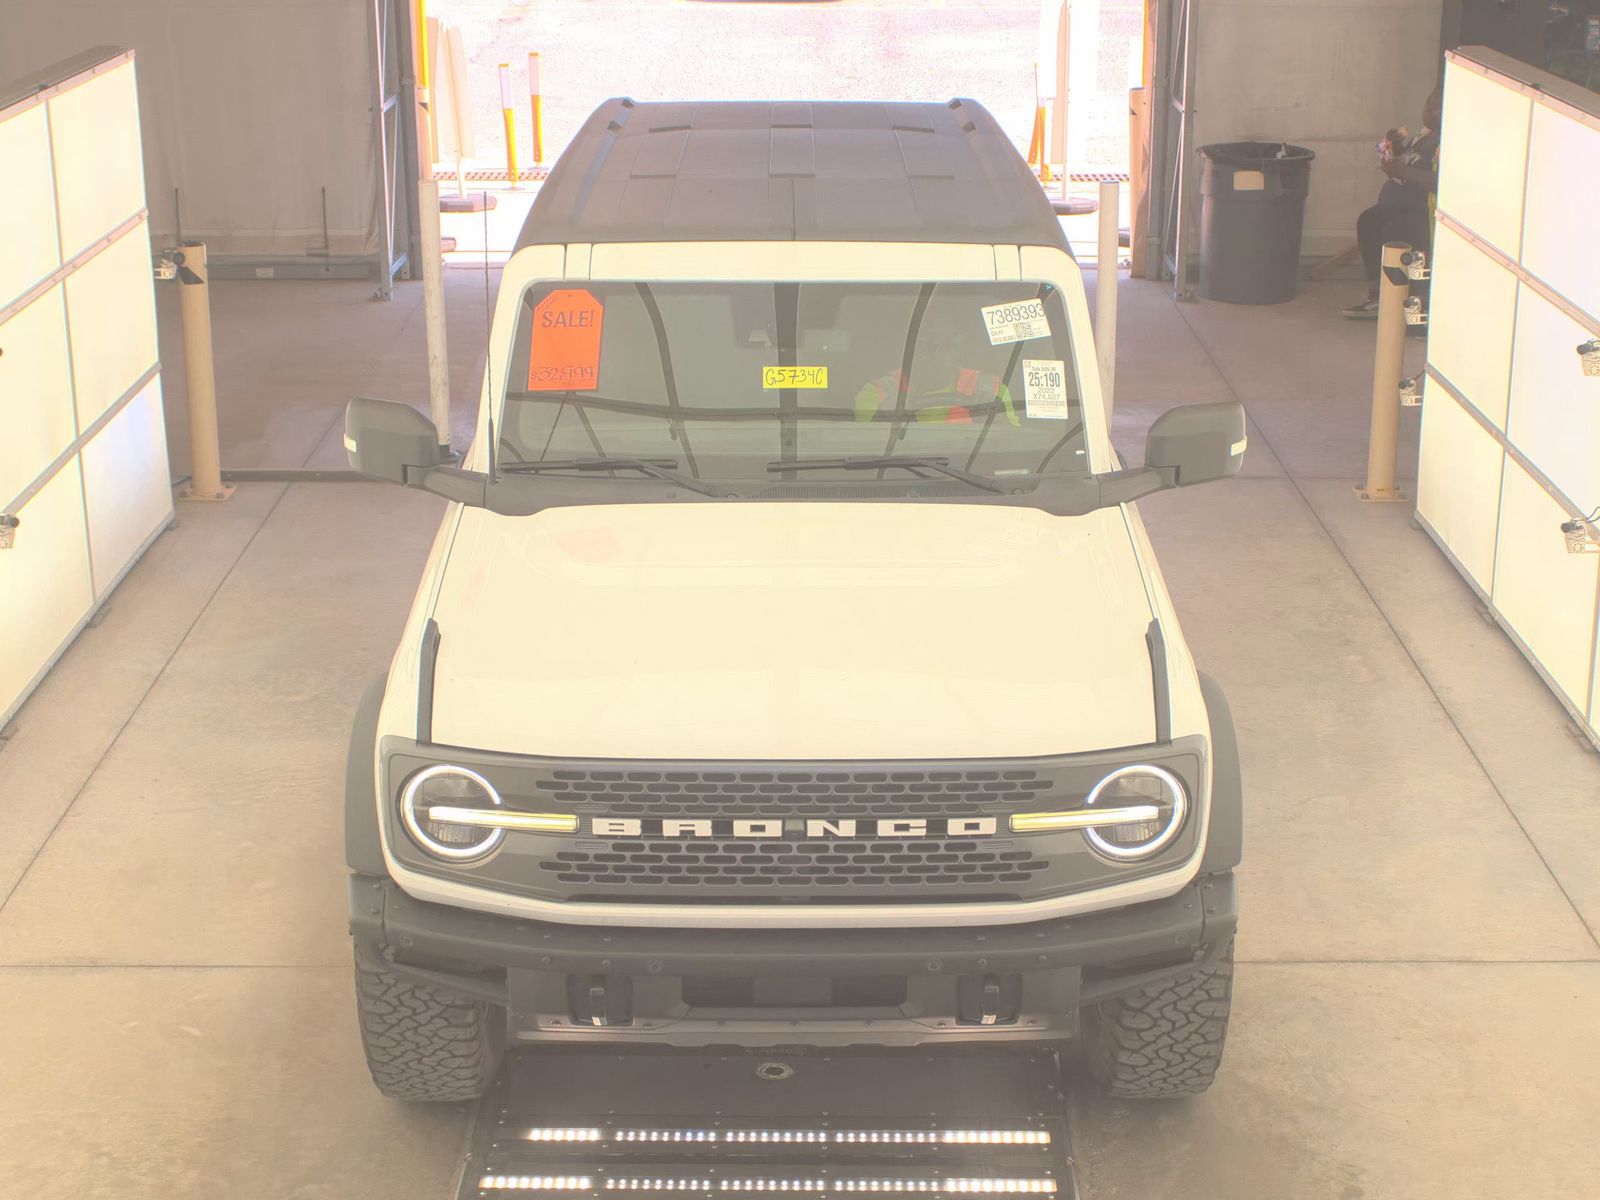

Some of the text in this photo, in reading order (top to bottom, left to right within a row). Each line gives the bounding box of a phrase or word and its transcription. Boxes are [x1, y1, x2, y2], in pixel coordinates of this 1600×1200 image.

[541, 309, 595, 328] SALE!
[986, 303, 1045, 325] 7389393
[1028, 372, 1060, 387] 25:190
[592, 817, 997, 837] BRONCO
